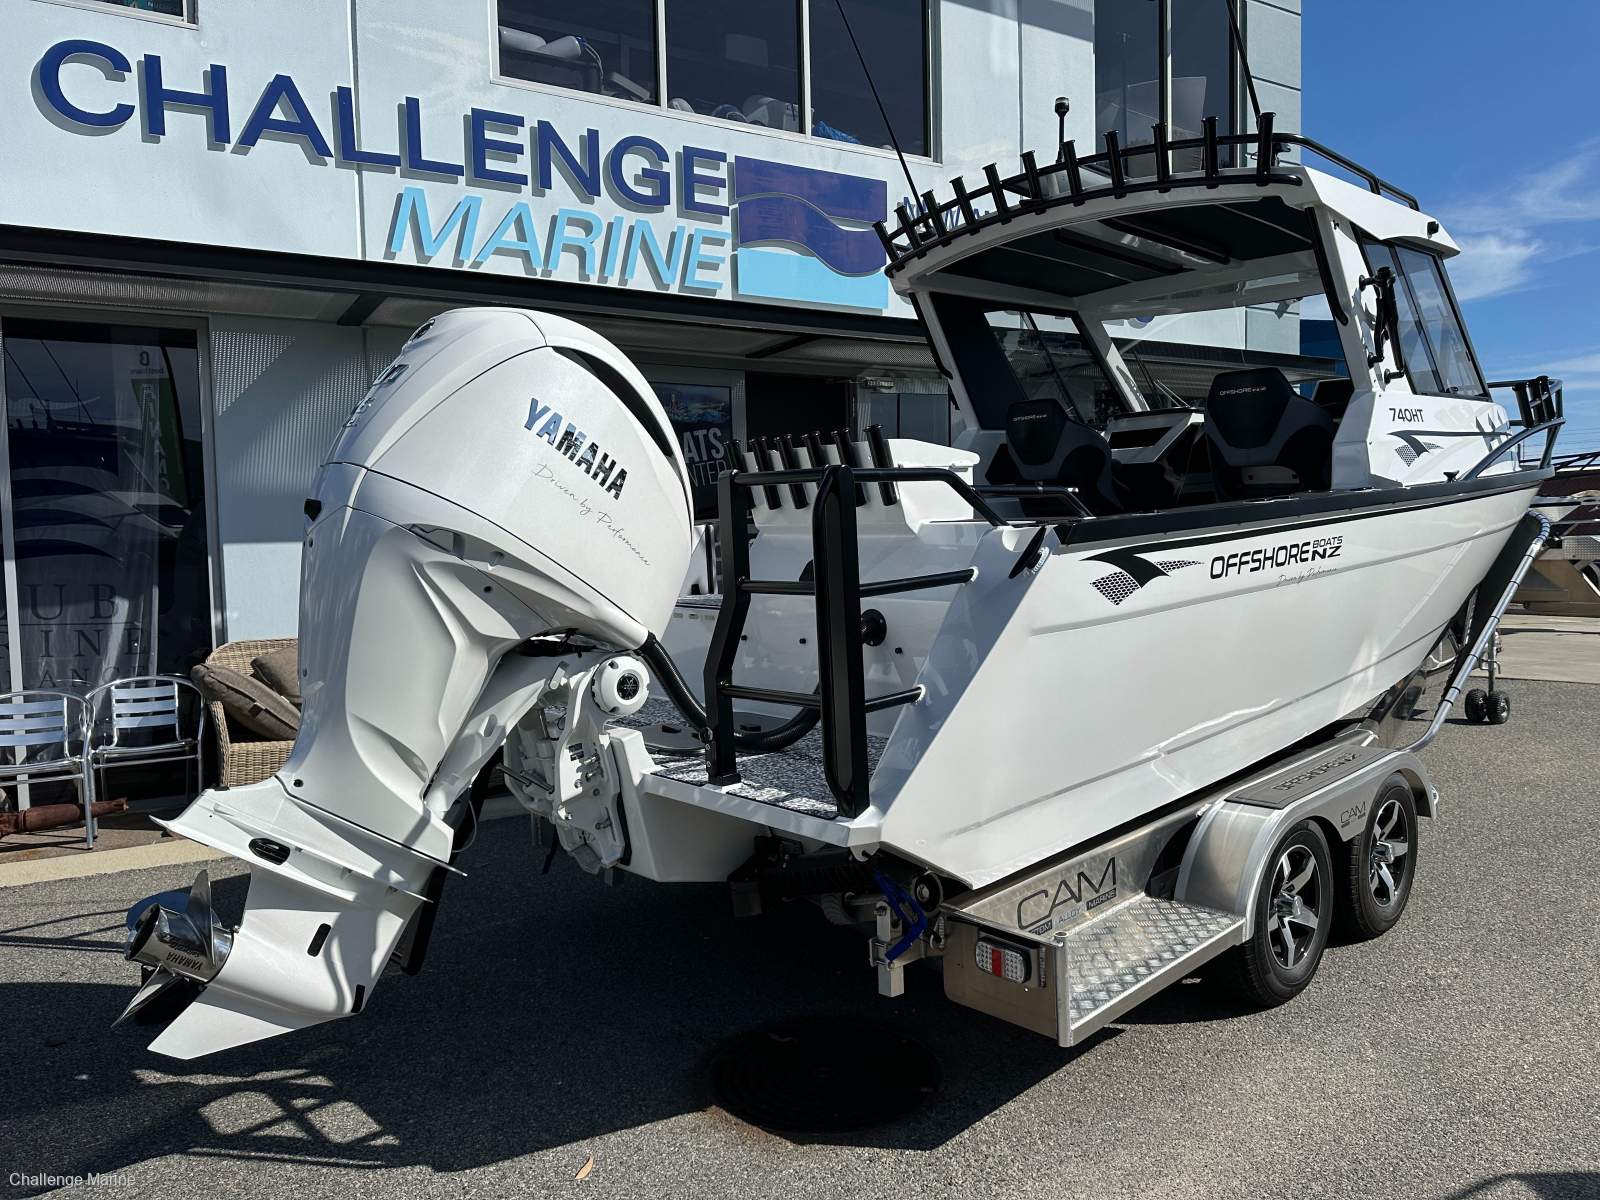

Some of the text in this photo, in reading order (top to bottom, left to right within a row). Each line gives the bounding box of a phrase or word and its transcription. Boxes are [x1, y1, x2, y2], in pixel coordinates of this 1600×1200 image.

[39, 38, 730, 217] CHALLENGE
[390, 185, 733, 290] MARINE
[1388, 407, 1425, 423] 740HT
[523, 397, 629, 501] YAMAHA
[532, 462, 579, 501] Driven
[578, 498, 593, 516] by
[1209, 541, 1343, 580] OFFSHORE NZ
[1312, 535, 1344, 549] BOATS
[0, 583, 119, 620] UB
[1340, 800, 1366, 824] CAM
[1017, 856, 1117, 930] CAM
[1087, 888, 1117, 911] MARINE
[165, 951, 204, 972] YAMAHA
